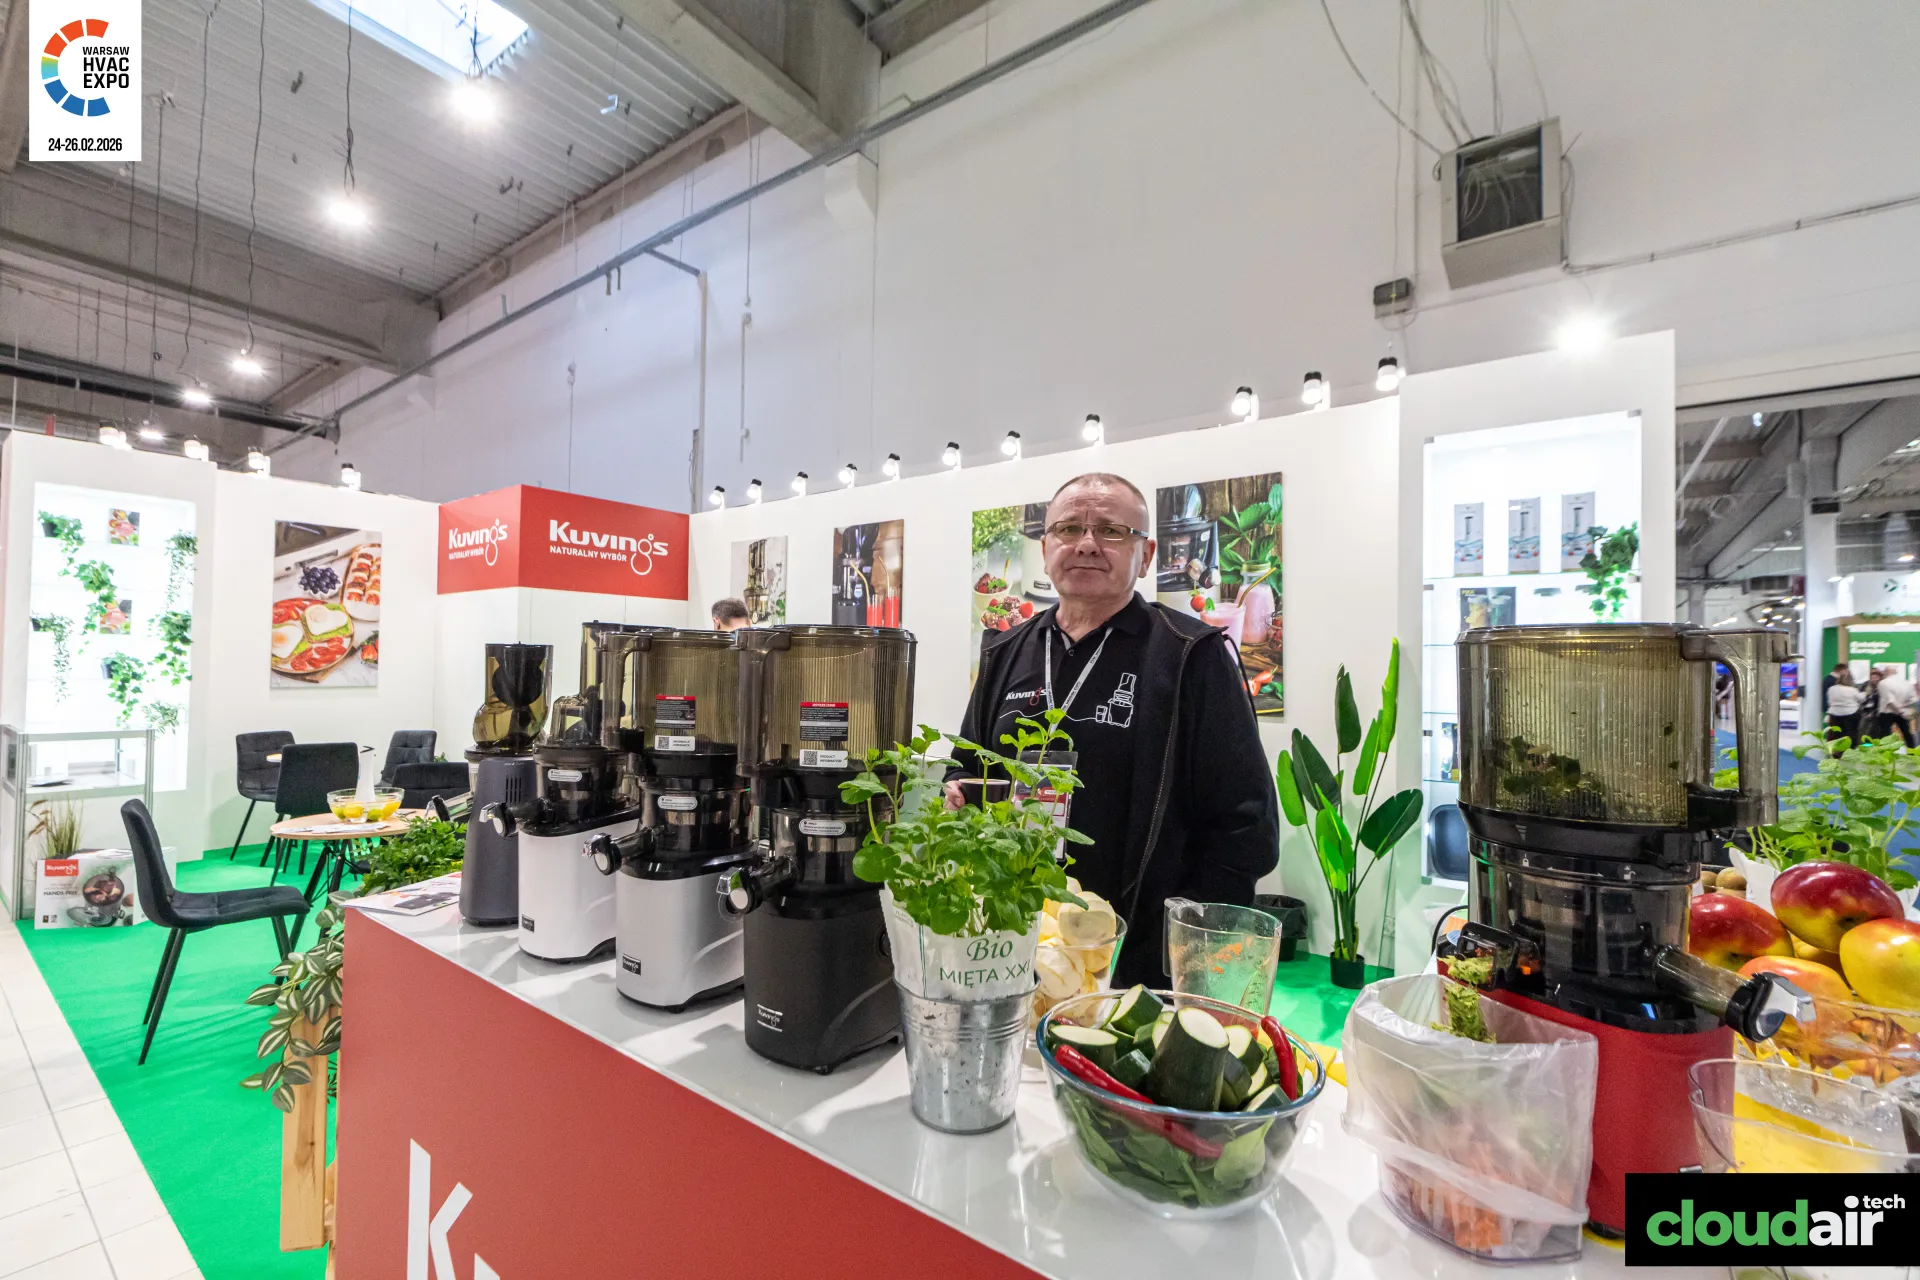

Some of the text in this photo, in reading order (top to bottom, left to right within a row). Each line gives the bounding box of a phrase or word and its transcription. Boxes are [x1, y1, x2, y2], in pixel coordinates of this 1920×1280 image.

[448, 518, 508, 567] Kuvings
[549, 519, 669, 576] Kuvings
[549, 545, 628, 563] NATURALNY WYBÓR
[966, 935, 1014, 962] Bio
[940, 967, 999, 989] MIĘTA
[406, 1137, 501, 1280] K
